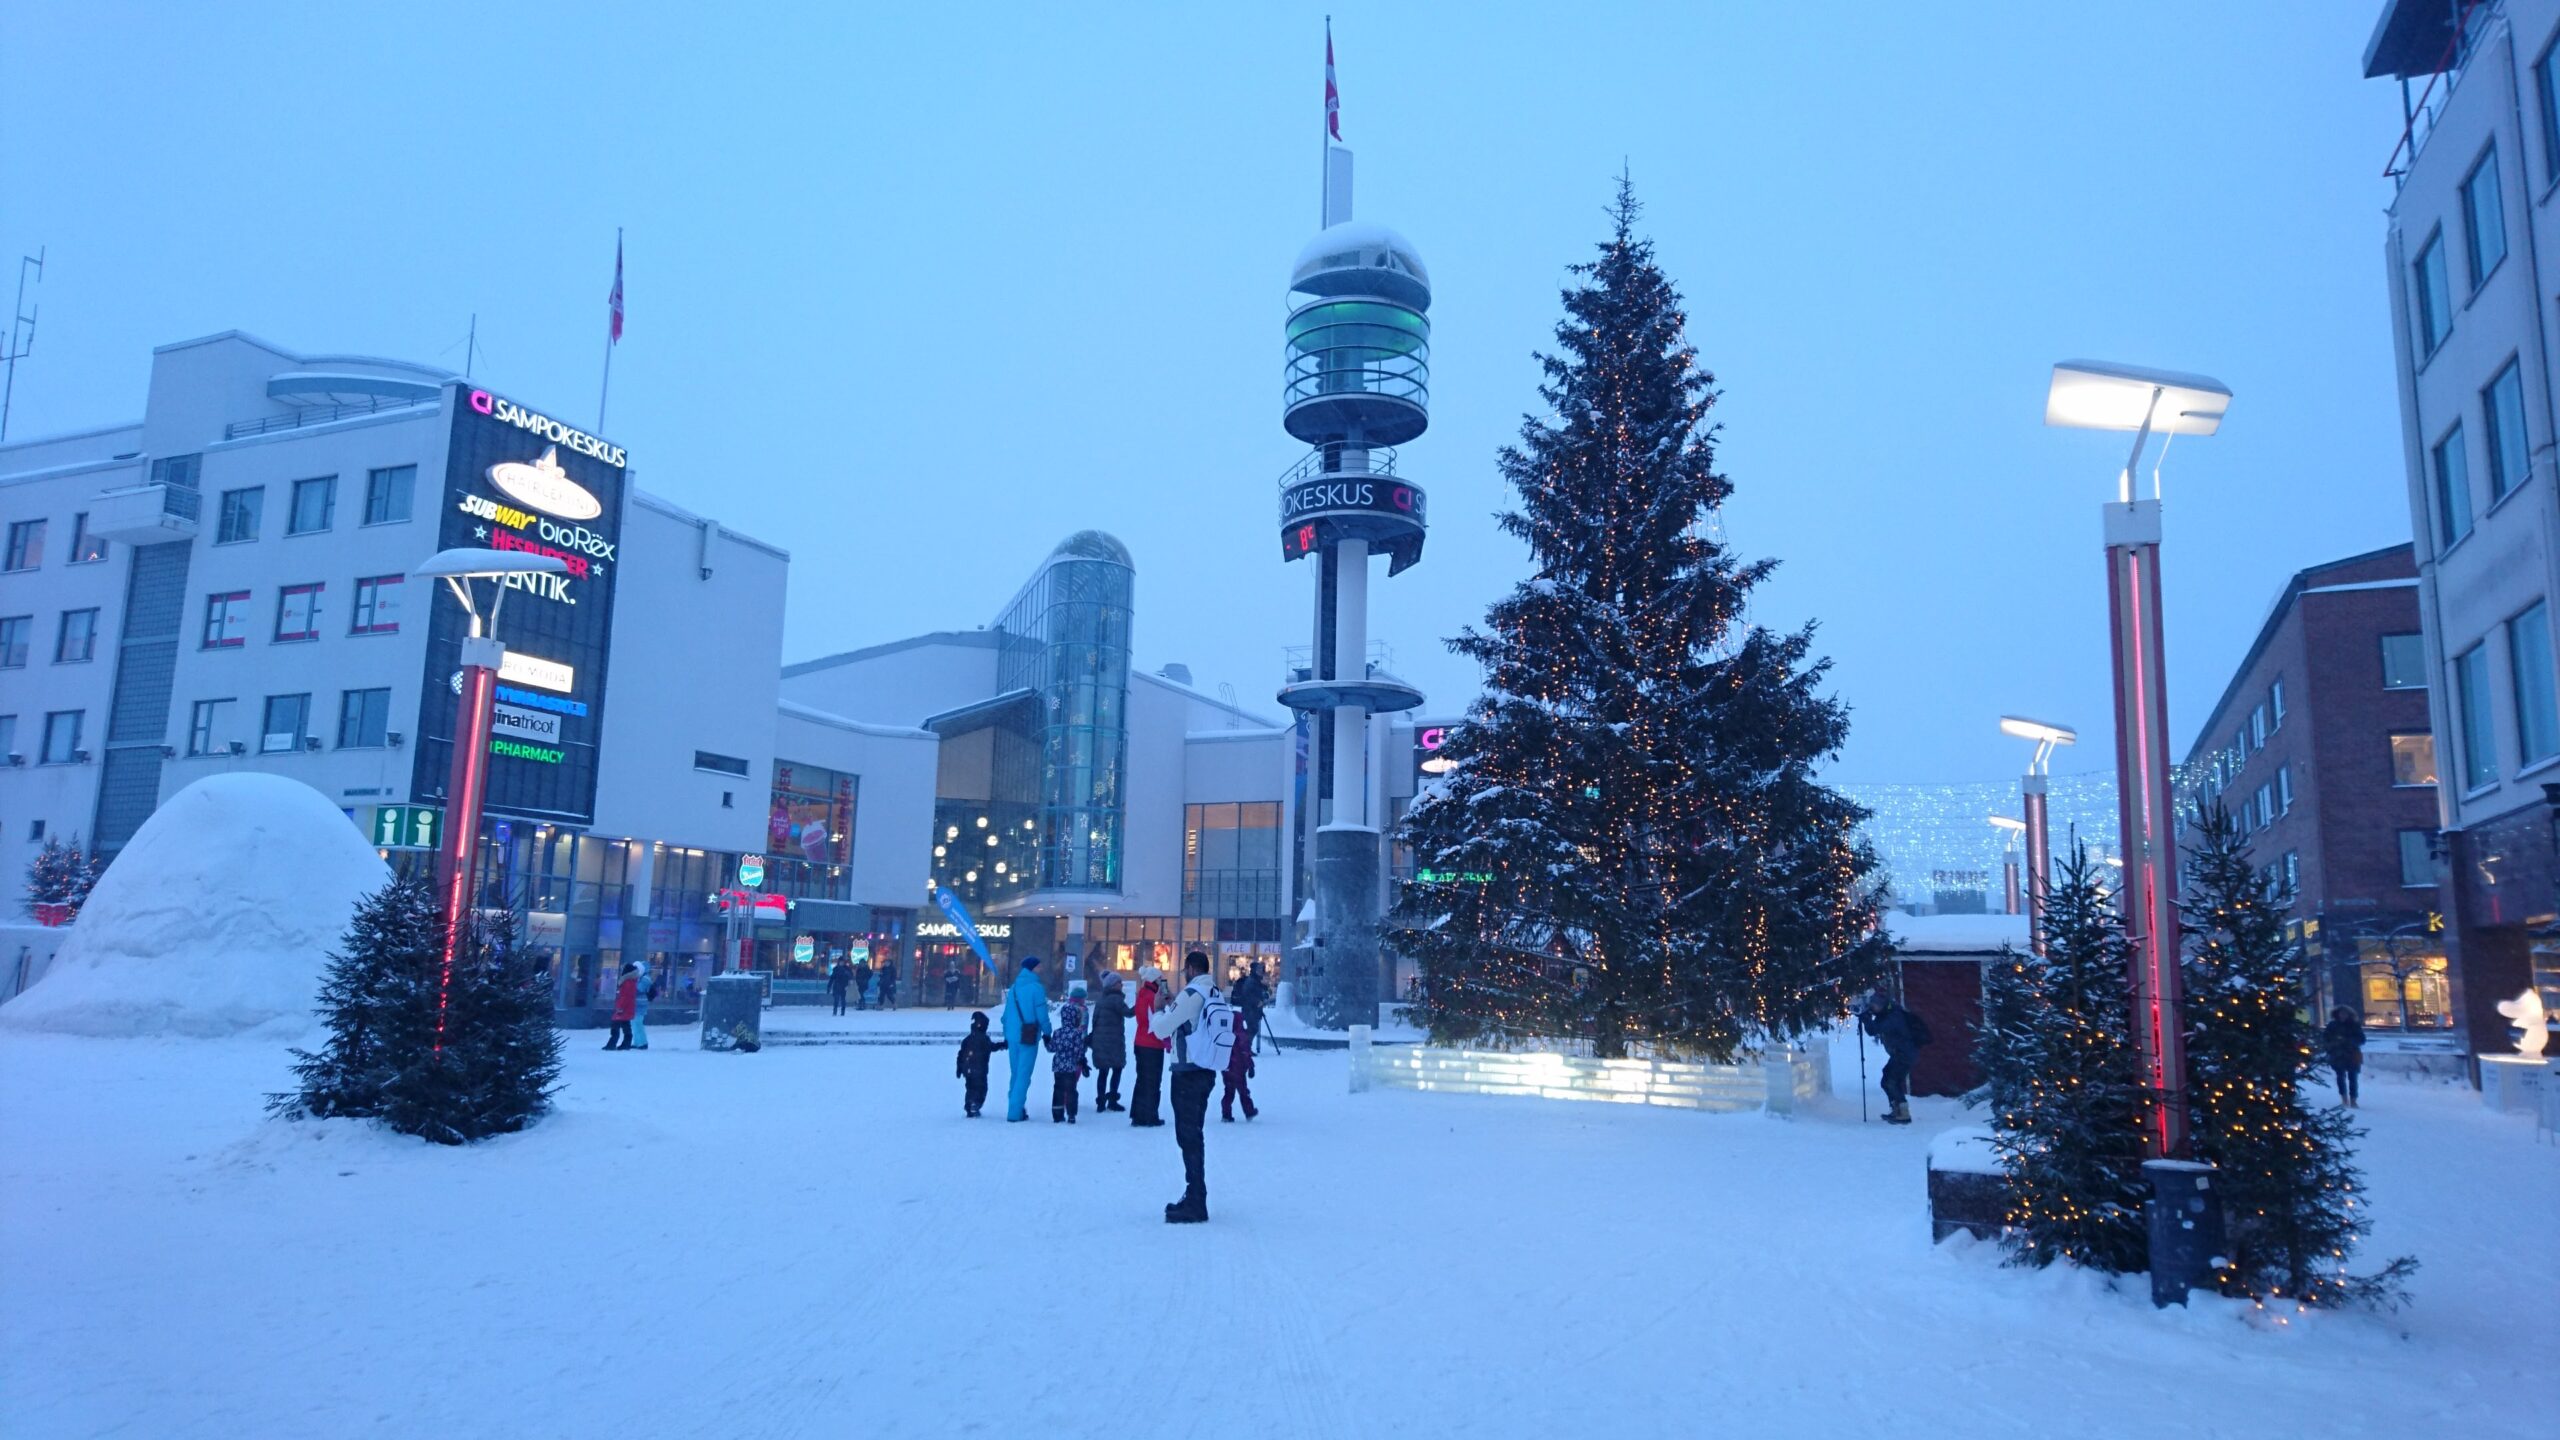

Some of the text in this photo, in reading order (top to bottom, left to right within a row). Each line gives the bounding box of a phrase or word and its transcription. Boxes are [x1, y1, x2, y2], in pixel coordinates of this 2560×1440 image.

[496, 399, 626, 468] SAMPOKESKUS
[459, 495, 537, 530] SUBWAY
[1282, 484, 1373, 517] OKESKUS
[494, 740, 566, 764] PHARMACY
[916, 923, 1011, 938] SAMPOSKUS
